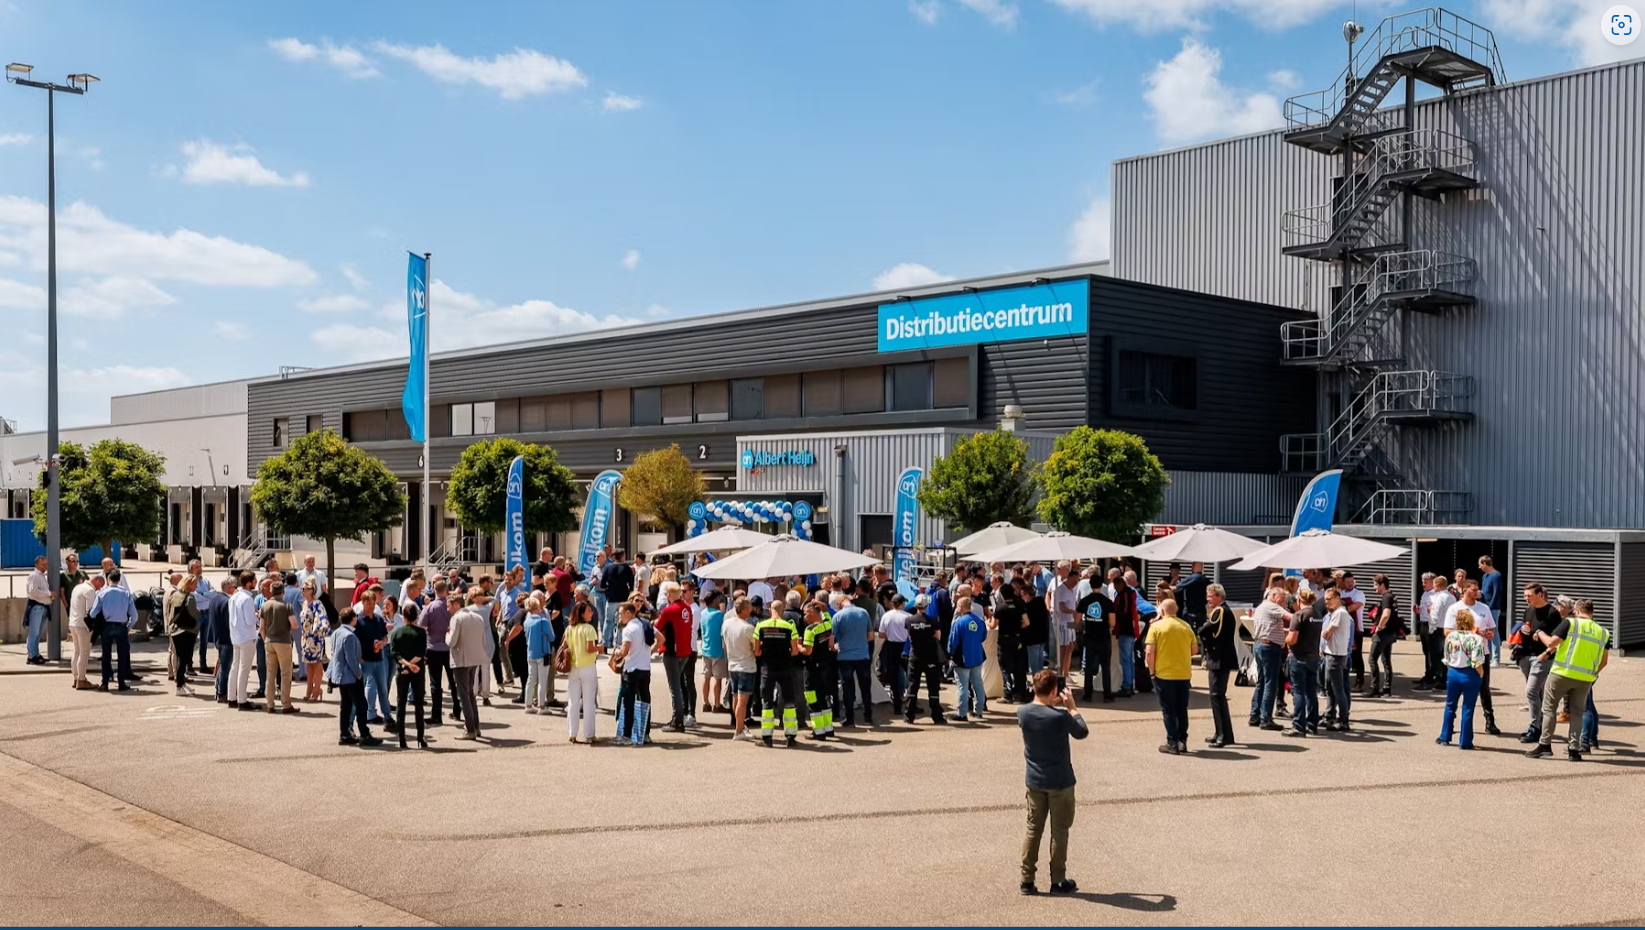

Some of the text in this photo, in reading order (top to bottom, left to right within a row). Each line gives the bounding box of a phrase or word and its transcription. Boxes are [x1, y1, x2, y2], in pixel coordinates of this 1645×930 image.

[886, 302, 1072, 340] Distributiecentrum
[616, 448, 622, 462] 3
[699, 445, 706, 459] 2
[754, 449, 814, 468] Albert Heijn
[418, 455, 424, 468] 6
[511, 512, 524, 562] lkom
